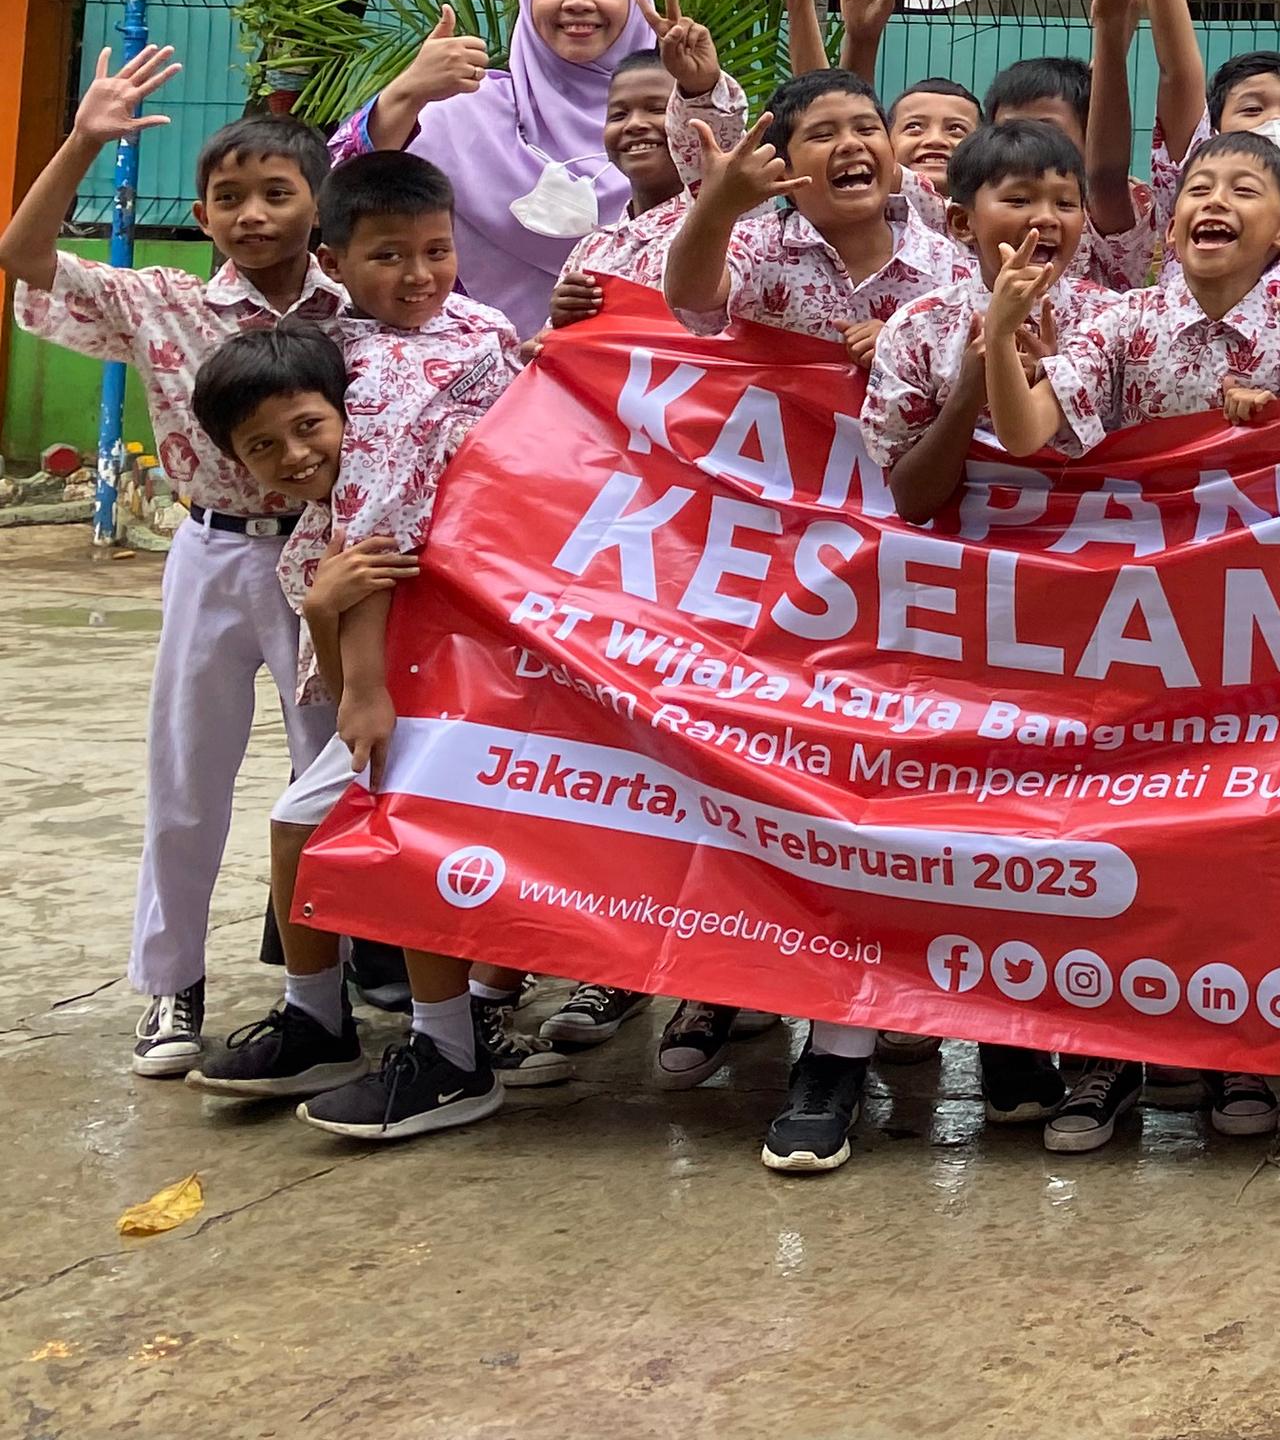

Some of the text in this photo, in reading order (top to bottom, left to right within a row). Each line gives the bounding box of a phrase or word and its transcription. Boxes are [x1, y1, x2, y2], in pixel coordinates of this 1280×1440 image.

[509, 592, 593, 642] PT
[606, 620, 791, 702] Wijaya
[803, 675, 961, 734] Karya
[977, 702, 1279, 751] Bangunan
[651, 704, 832, 777] Rangka
[848, 744, 1208, 806] Memperingati
[477, 746, 1097, 899] Jakarta, 02 Februari 2023
[519, 877, 882, 965] www.wikagedung.co.id
